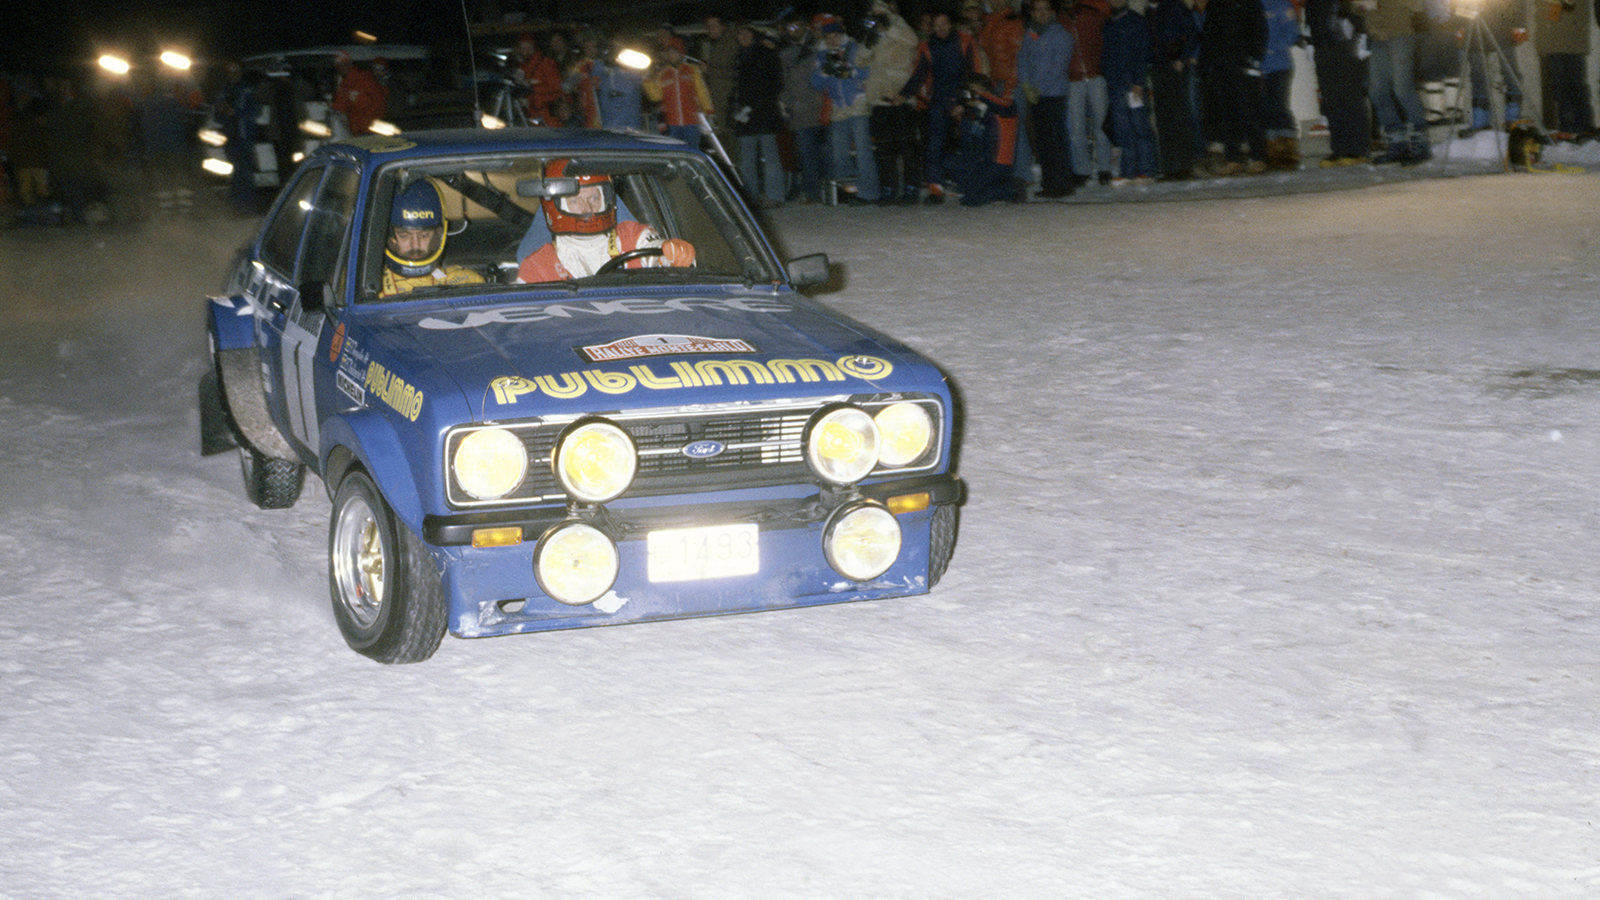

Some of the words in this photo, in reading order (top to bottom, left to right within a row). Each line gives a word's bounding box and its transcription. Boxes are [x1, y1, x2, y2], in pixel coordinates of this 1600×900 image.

[590, 346, 645, 359] RALLYE
[338, 373, 363, 404] MICHELIN
[692, 442, 716, 455] Ford
[680, 530, 753, 565] 1493
